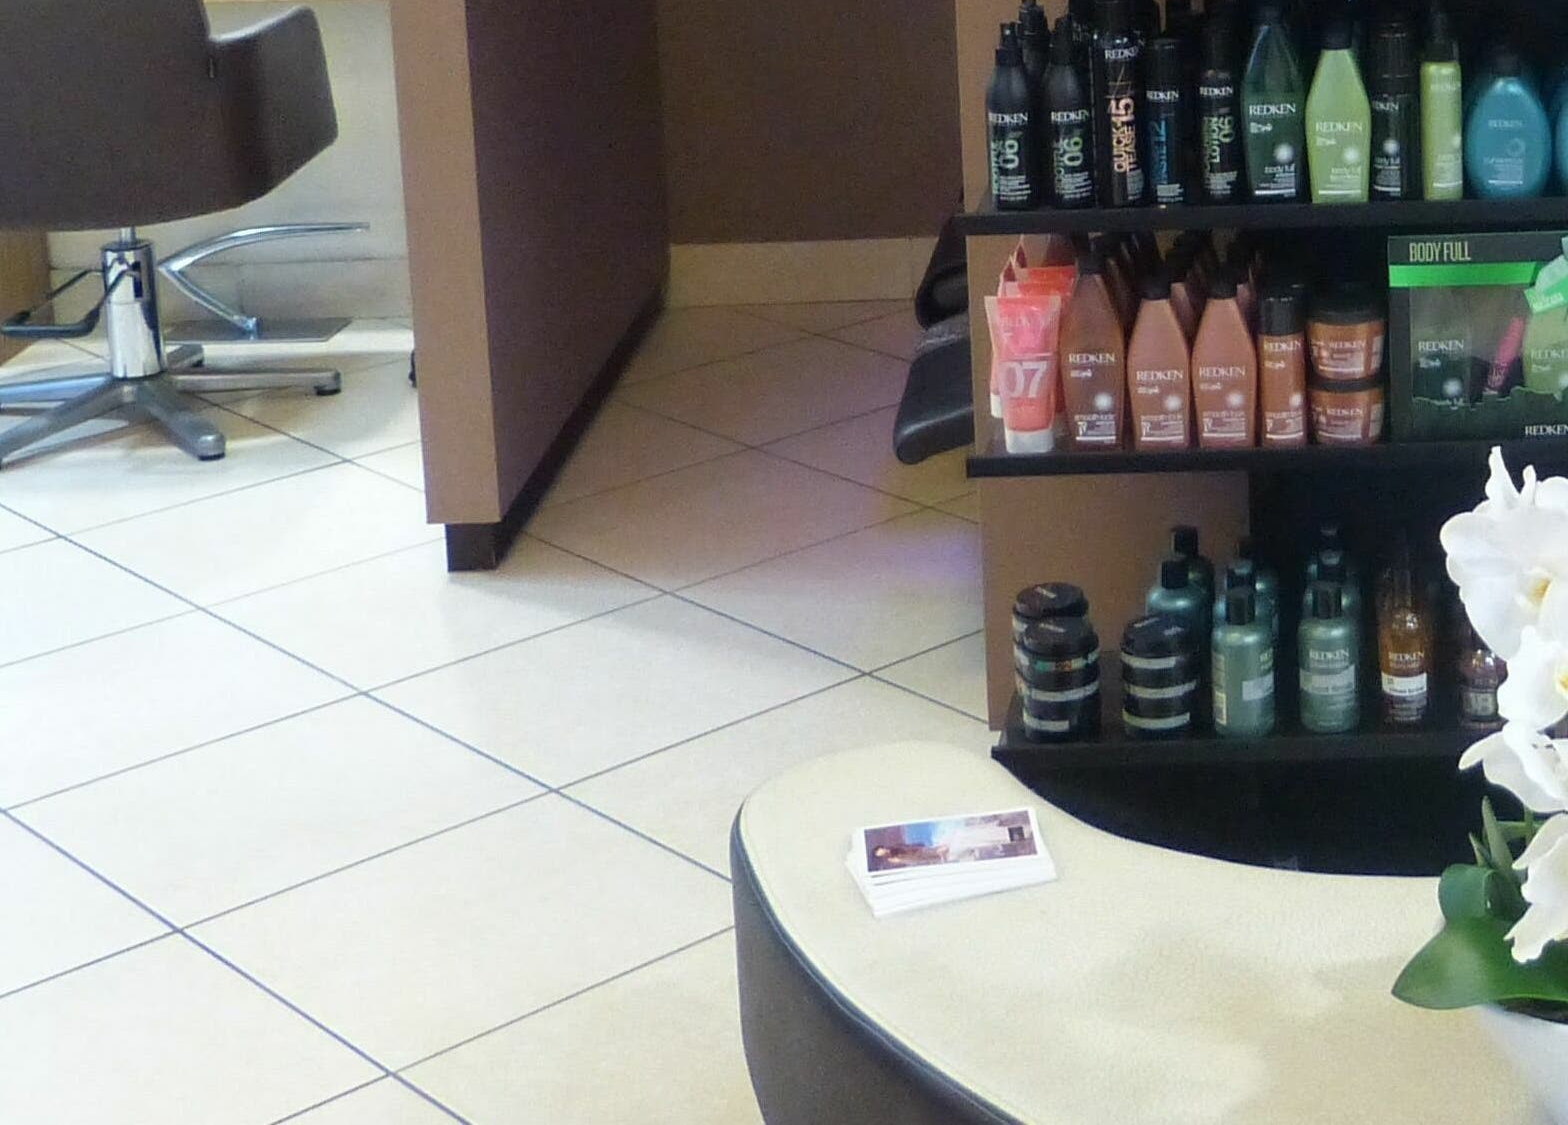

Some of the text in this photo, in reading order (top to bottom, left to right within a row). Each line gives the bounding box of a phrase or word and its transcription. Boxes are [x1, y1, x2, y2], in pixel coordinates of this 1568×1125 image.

[1147, 90, 1180, 101] REDKEN
[1200, 86, 1234, 97] REDKEN
[1051, 109, 1090, 123] REDKEN
[1109, 97, 1136, 124] 15
[1249, 103, 1296, 116] REDKEN
[988, 111, 1028, 125] REDKEN
[1315, 122, 1363, 133] REDKEN
[1062, 136, 1083, 168] 06
[1111, 123, 1127, 173] QUICK
[1409, 241, 1472, 262] BODY FULL
[1418, 339, 1465, 352] REDKEN
[1068, 353, 1116, 364] REDKEN
[1136, 370, 1184, 381] REDKEN
[1199, 366, 1246, 377] REDKEN
[1003, 360, 1048, 398] 07
[1309, 649, 1350, 660] REDKEN
